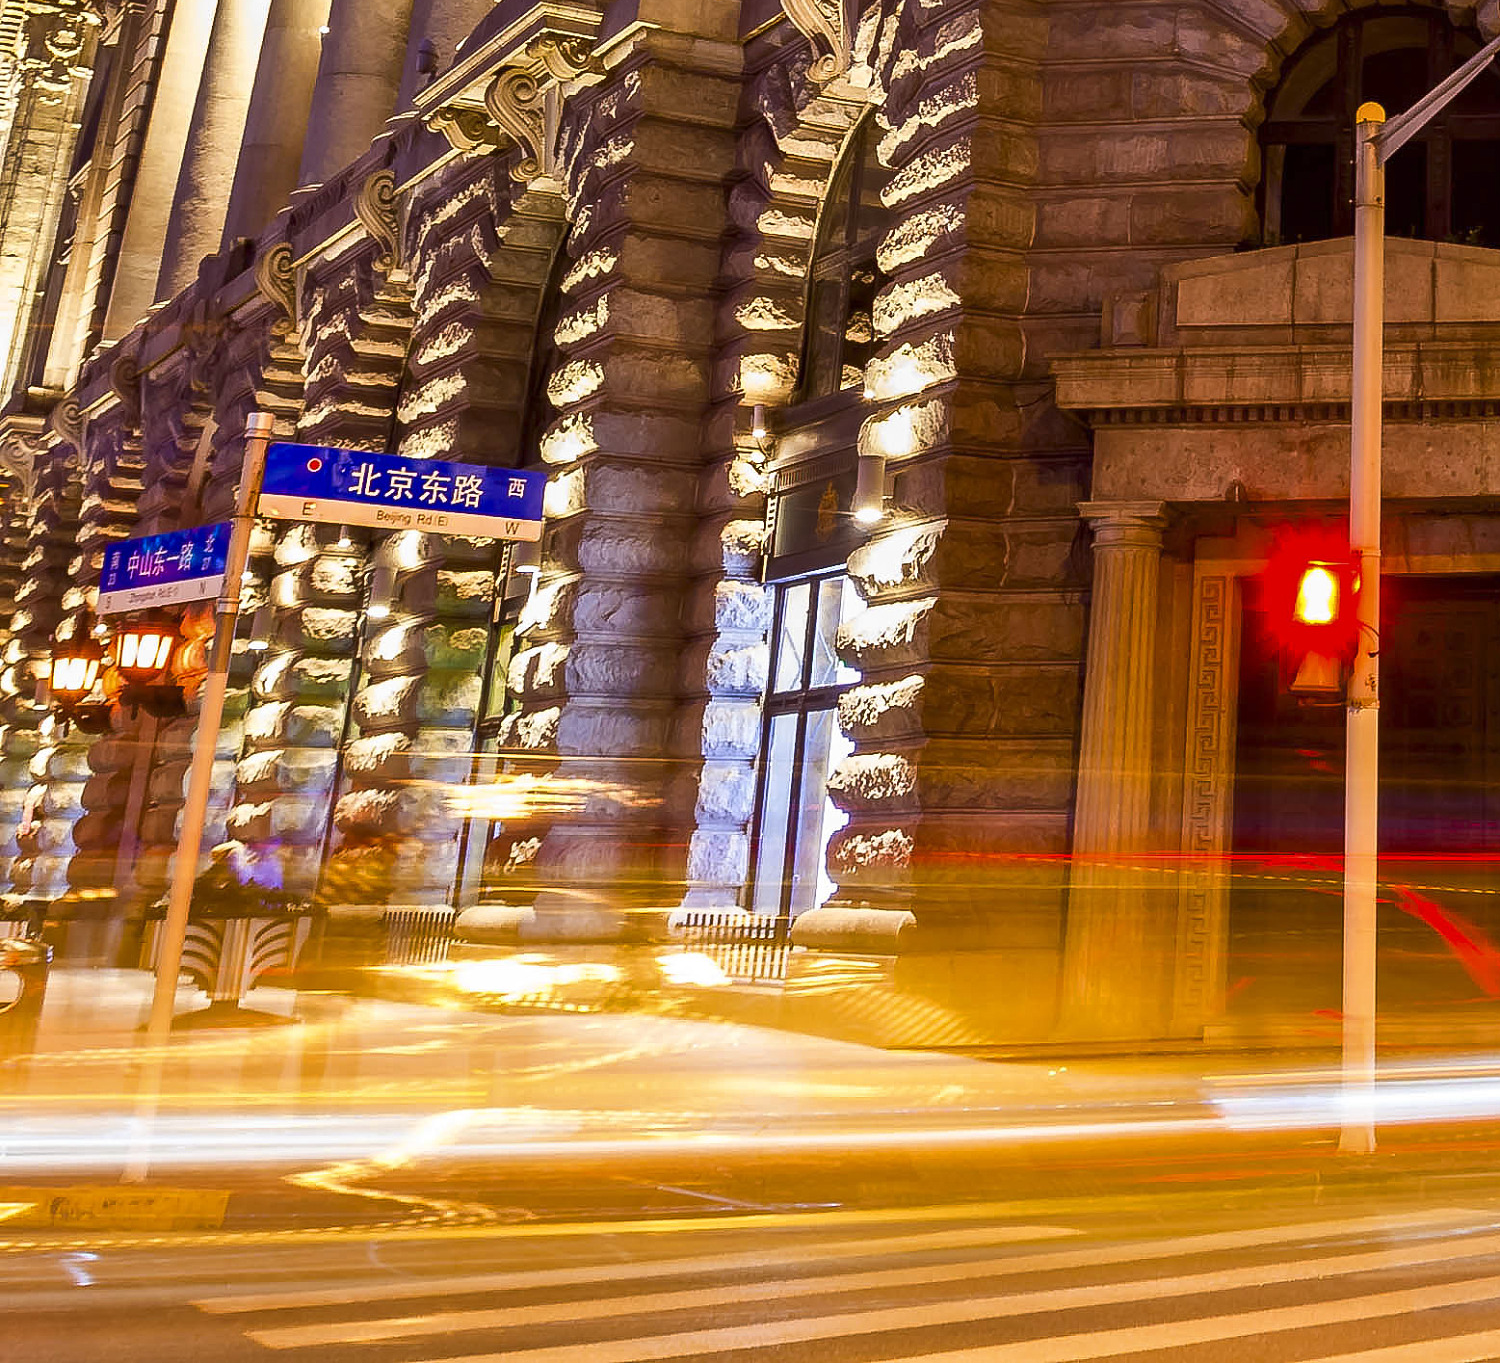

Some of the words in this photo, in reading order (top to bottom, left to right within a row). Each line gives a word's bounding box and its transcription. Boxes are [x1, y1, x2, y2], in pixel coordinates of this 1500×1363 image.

[348, 463, 484, 509] 北京东路
[508, 477, 527, 499] 西
[505, 521, 519, 535] W
[127, 540, 194, 580] 中山东一路
